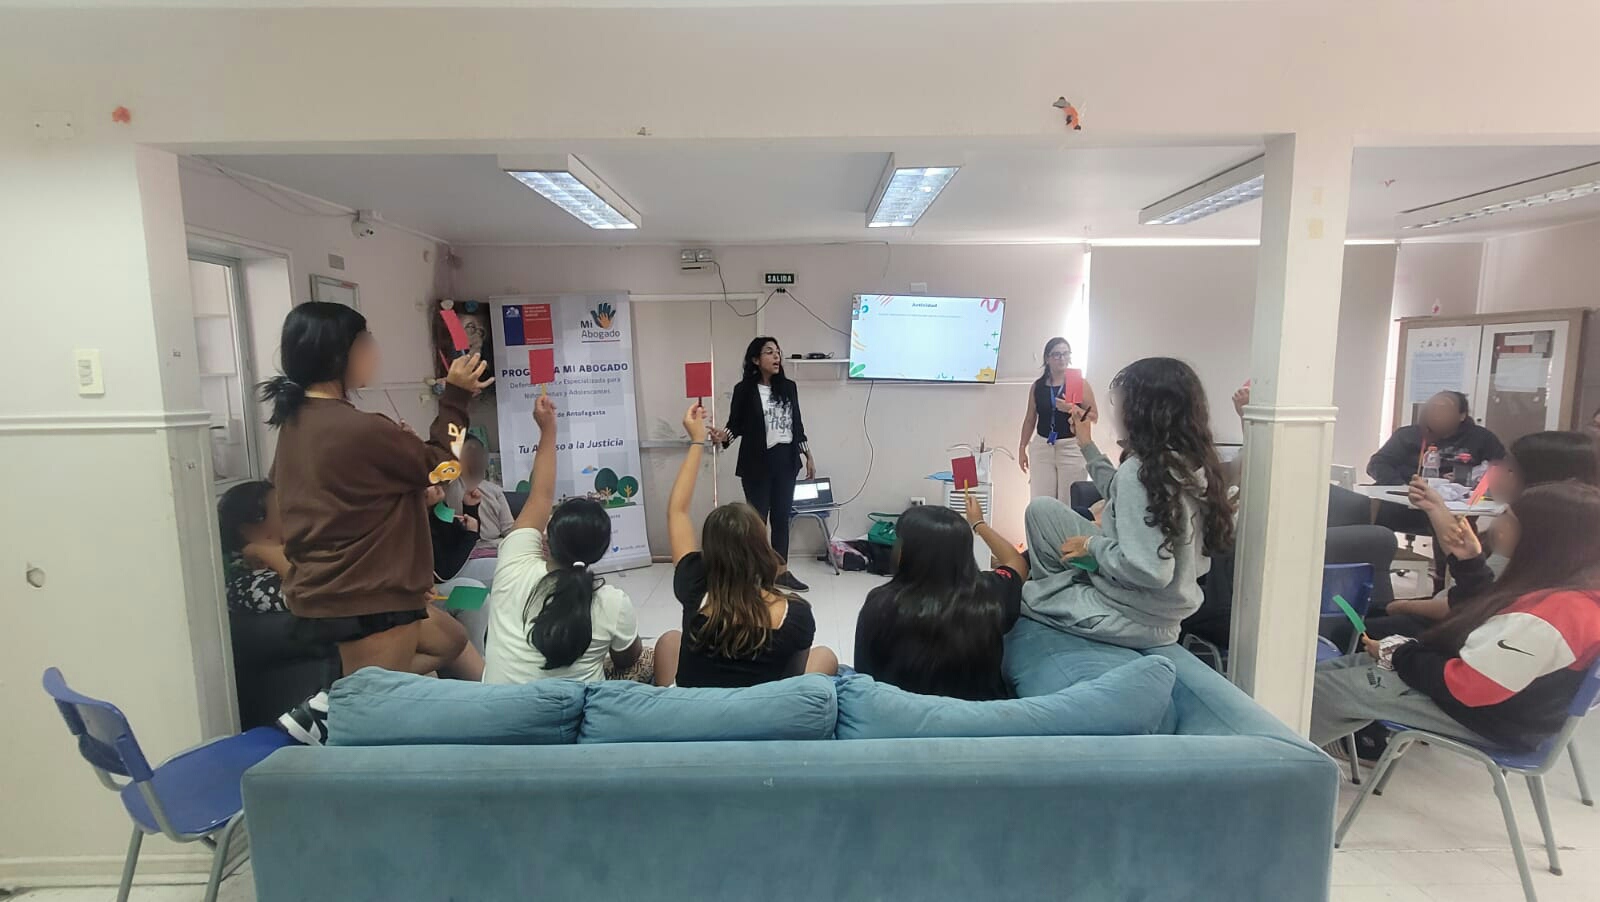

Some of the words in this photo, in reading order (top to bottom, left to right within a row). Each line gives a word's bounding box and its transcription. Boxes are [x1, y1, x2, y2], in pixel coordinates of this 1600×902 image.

[767, 274, 792, 282] SALIDA
[580, 320, 593, 329] Mi
[581, 329, 621, 340] Abogado
[502, 366, 561, 378] PROGA
[563, 364, 576, 374] MI
[579, 362, 629, 373] ABOGADO
[518, 445, 530, 454] Tu
[532, 444, 566, 453] Aso
[576, 441, 585, 449] la
[587, 438, 624, 449] Justicia
